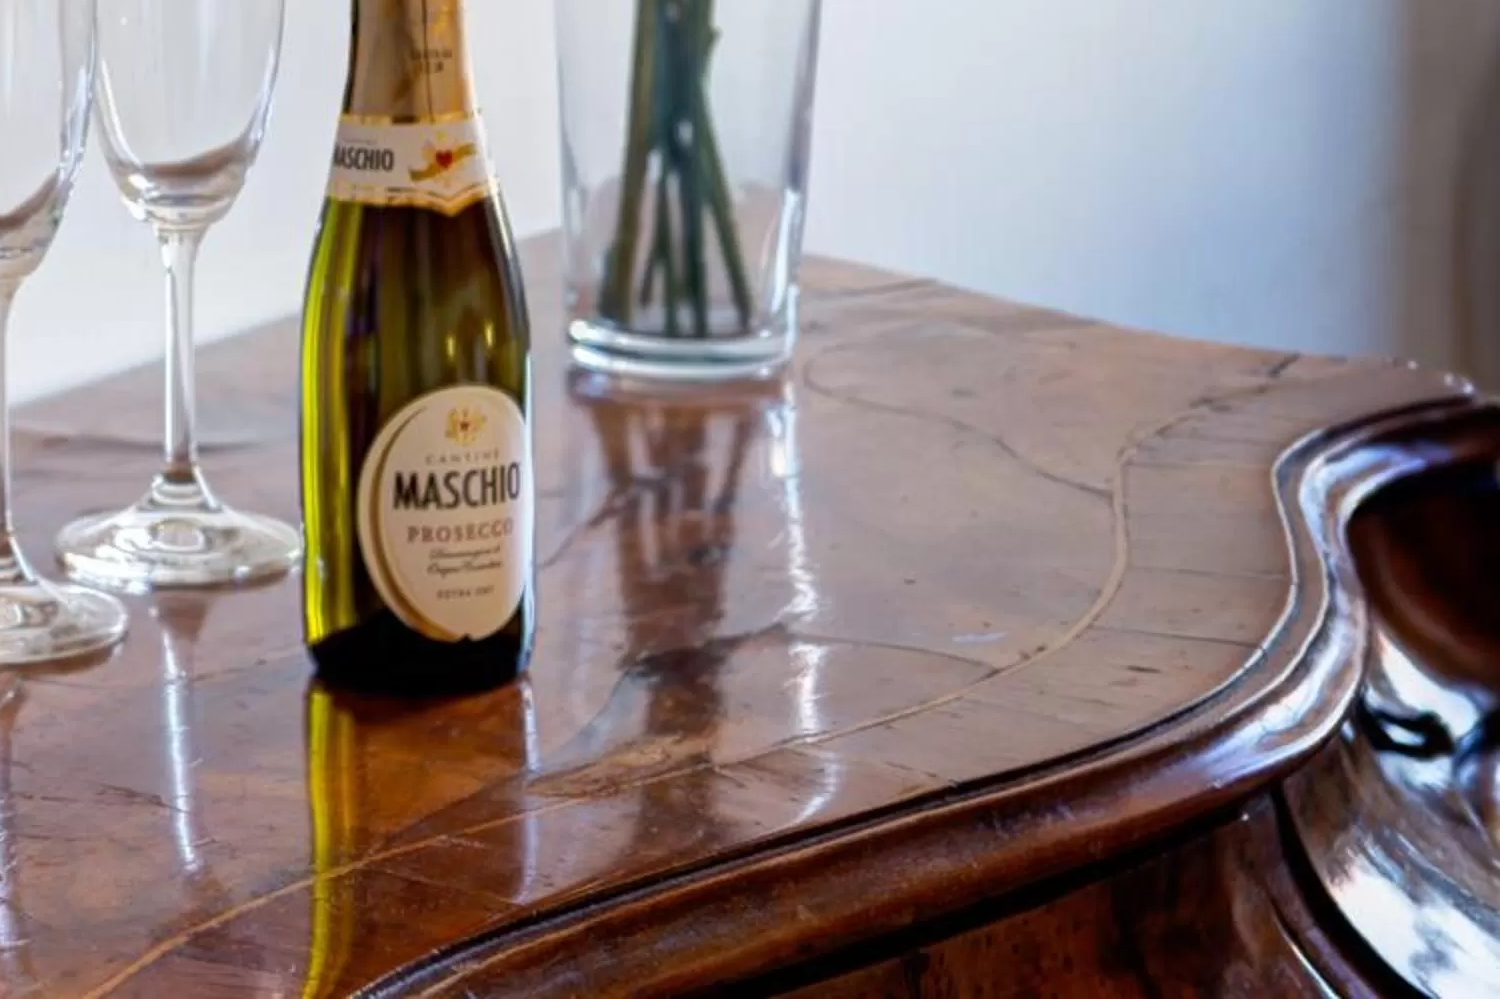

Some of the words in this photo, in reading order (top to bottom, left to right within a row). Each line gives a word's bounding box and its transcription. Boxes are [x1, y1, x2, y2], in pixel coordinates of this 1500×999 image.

[334, 143, 395, 172] ASCHIO
[392, 460, 522, 511] MASCHIO
[407, 516, 515, 544] PROSECCO
